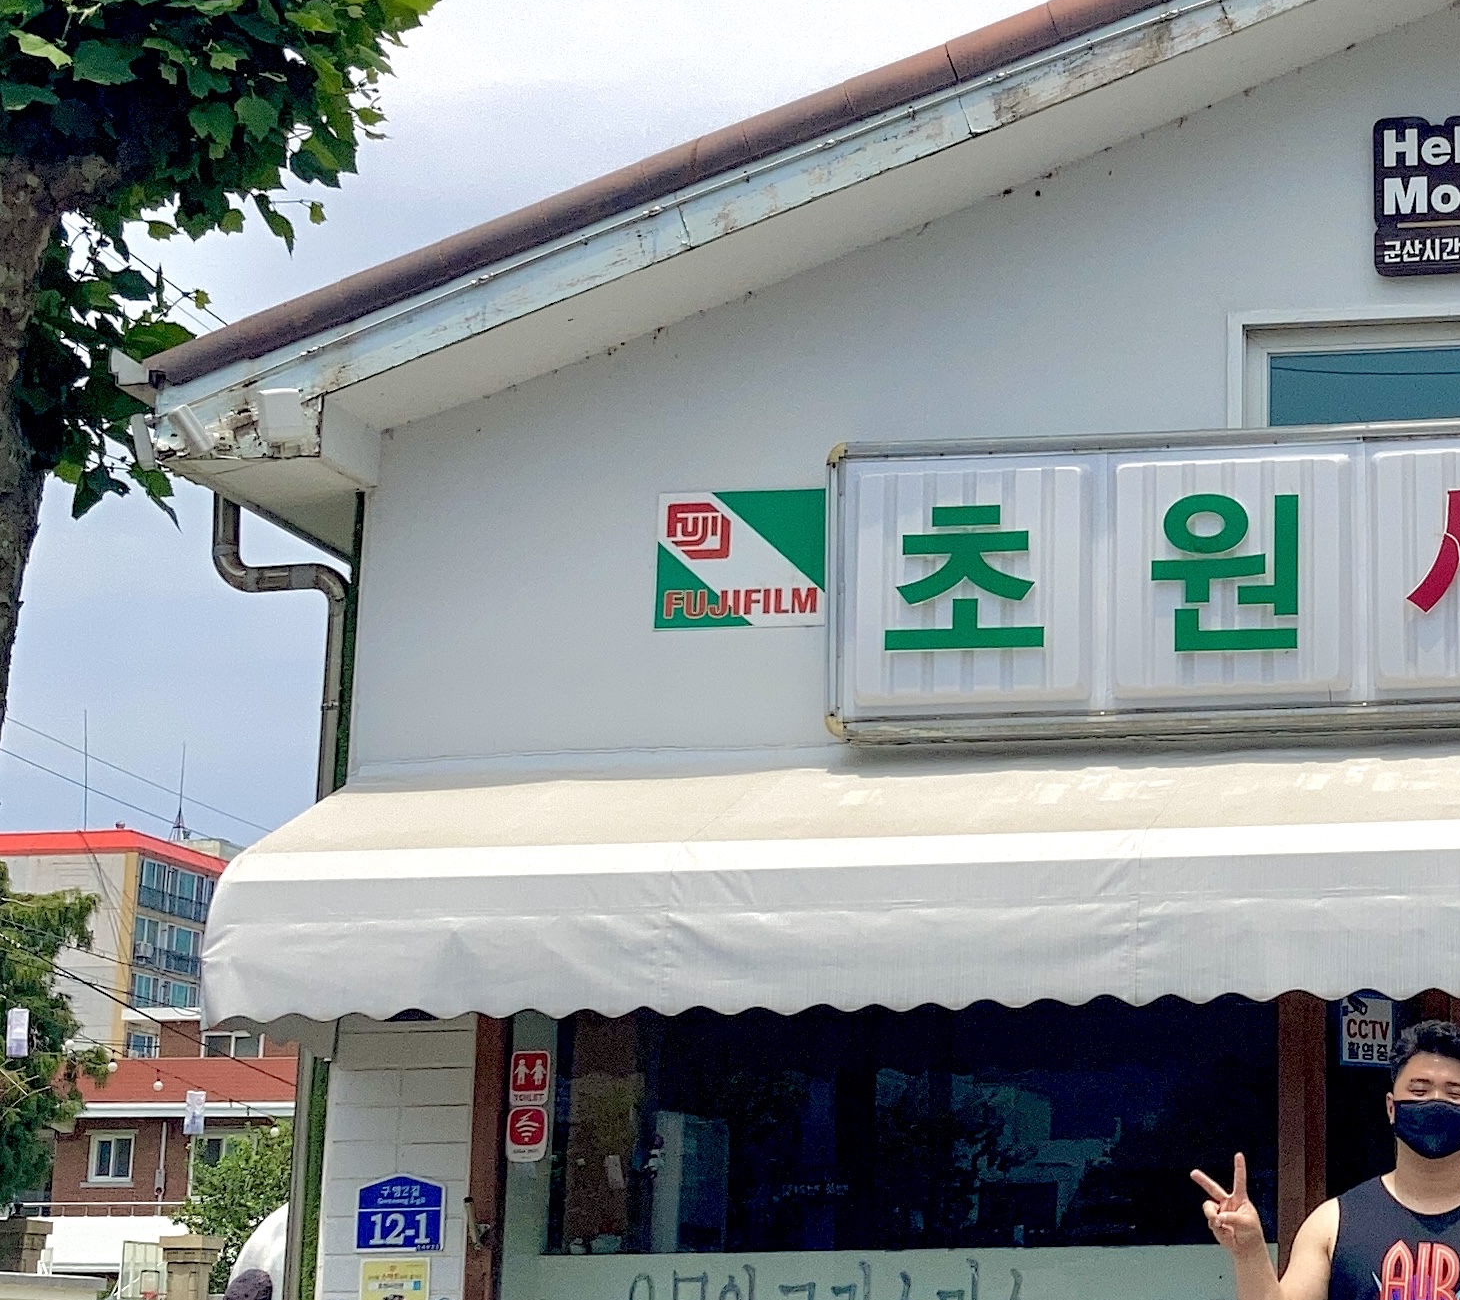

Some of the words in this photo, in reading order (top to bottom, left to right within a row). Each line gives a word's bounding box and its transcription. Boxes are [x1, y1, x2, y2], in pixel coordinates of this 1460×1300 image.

[663, 586, 818, 620] FUJIFILM
[1346, 1018, 1390, 1041] CCTV
[369, 1212, 431, 1246] 12-1
